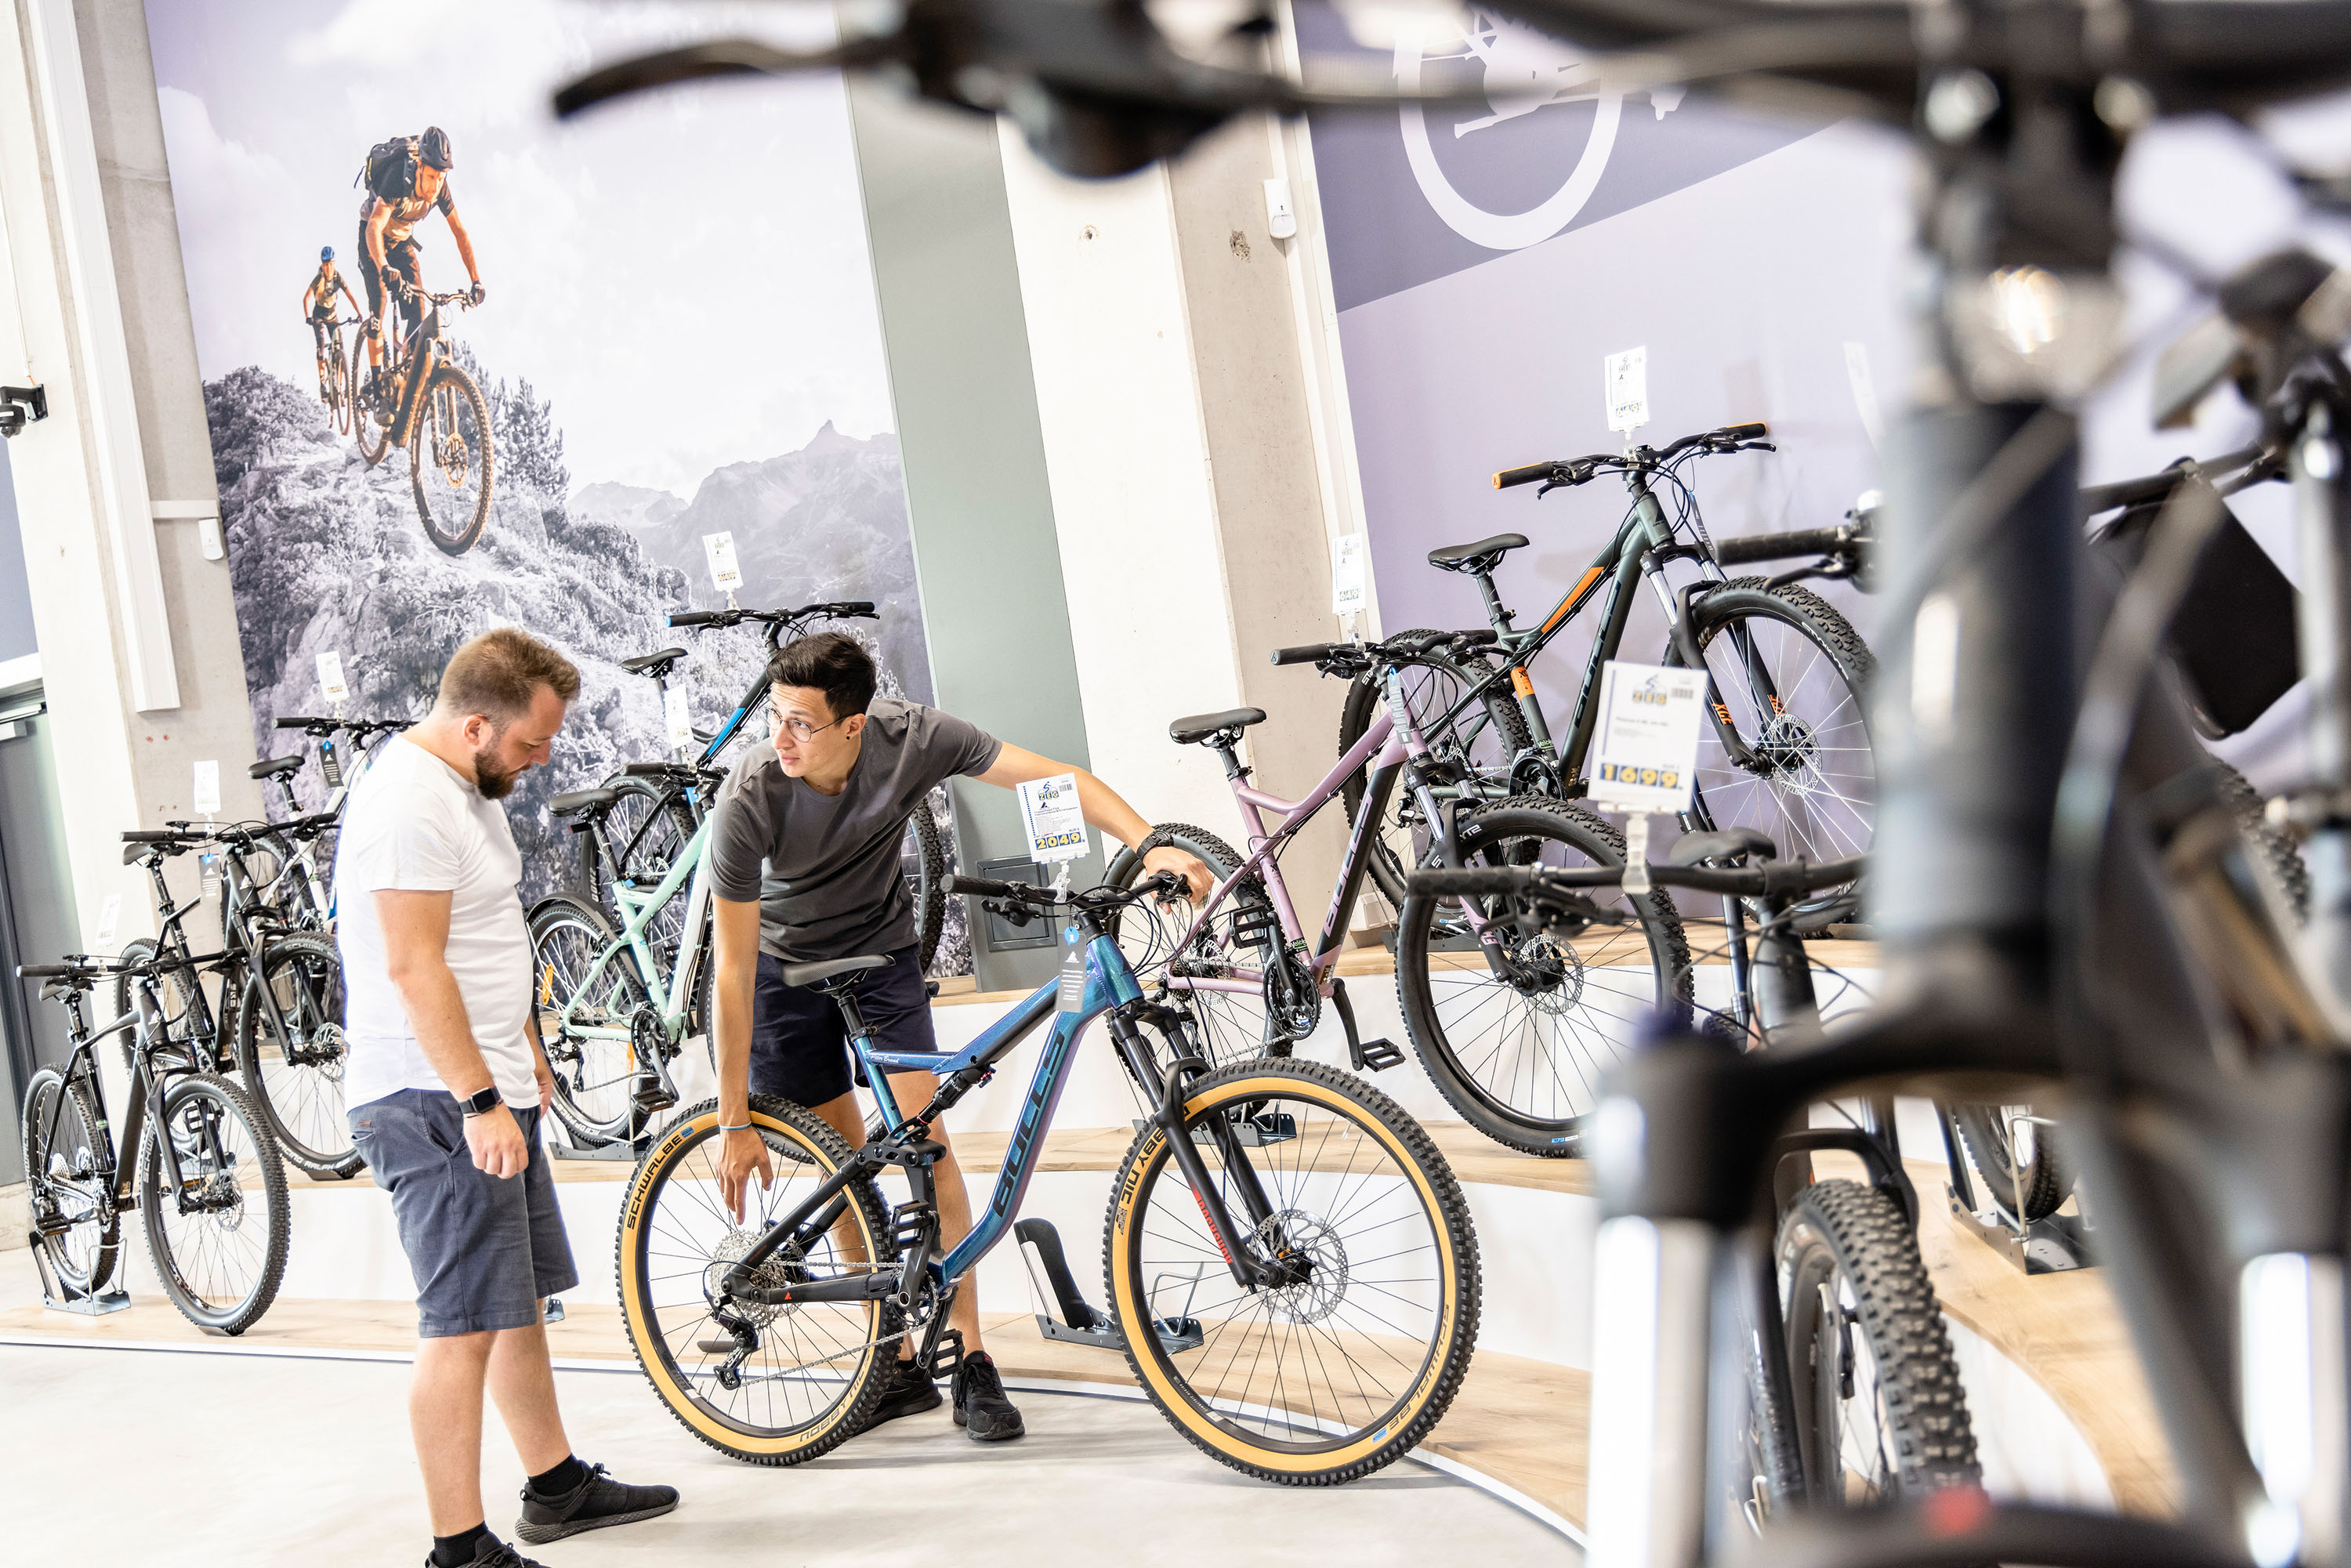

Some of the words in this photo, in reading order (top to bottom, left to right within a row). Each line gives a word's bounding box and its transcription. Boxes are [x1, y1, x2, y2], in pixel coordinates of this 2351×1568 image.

[1574, 579, 1621, 729] BULLS
[1038, 791, 1059, 800] ZEG
[1602, 764, 1679, 788] 1699
[1036, 833, 1081, 849] 2049
[1323, 792, 1373, 937] BULLS
[143, 1124, 157, 1183] SCHWA
[993, 1030, 1065, 1218] BULLS
[627, 1135, 682, 1229] SCHWALBE
[1121, 1169, 1140, 1204] NIC
[1389, 1304, 1450, 1431] SCHWALBE
[799, 1399, 846, 1442] NOBBY
[849, 1371, 864, 1398] NIC
